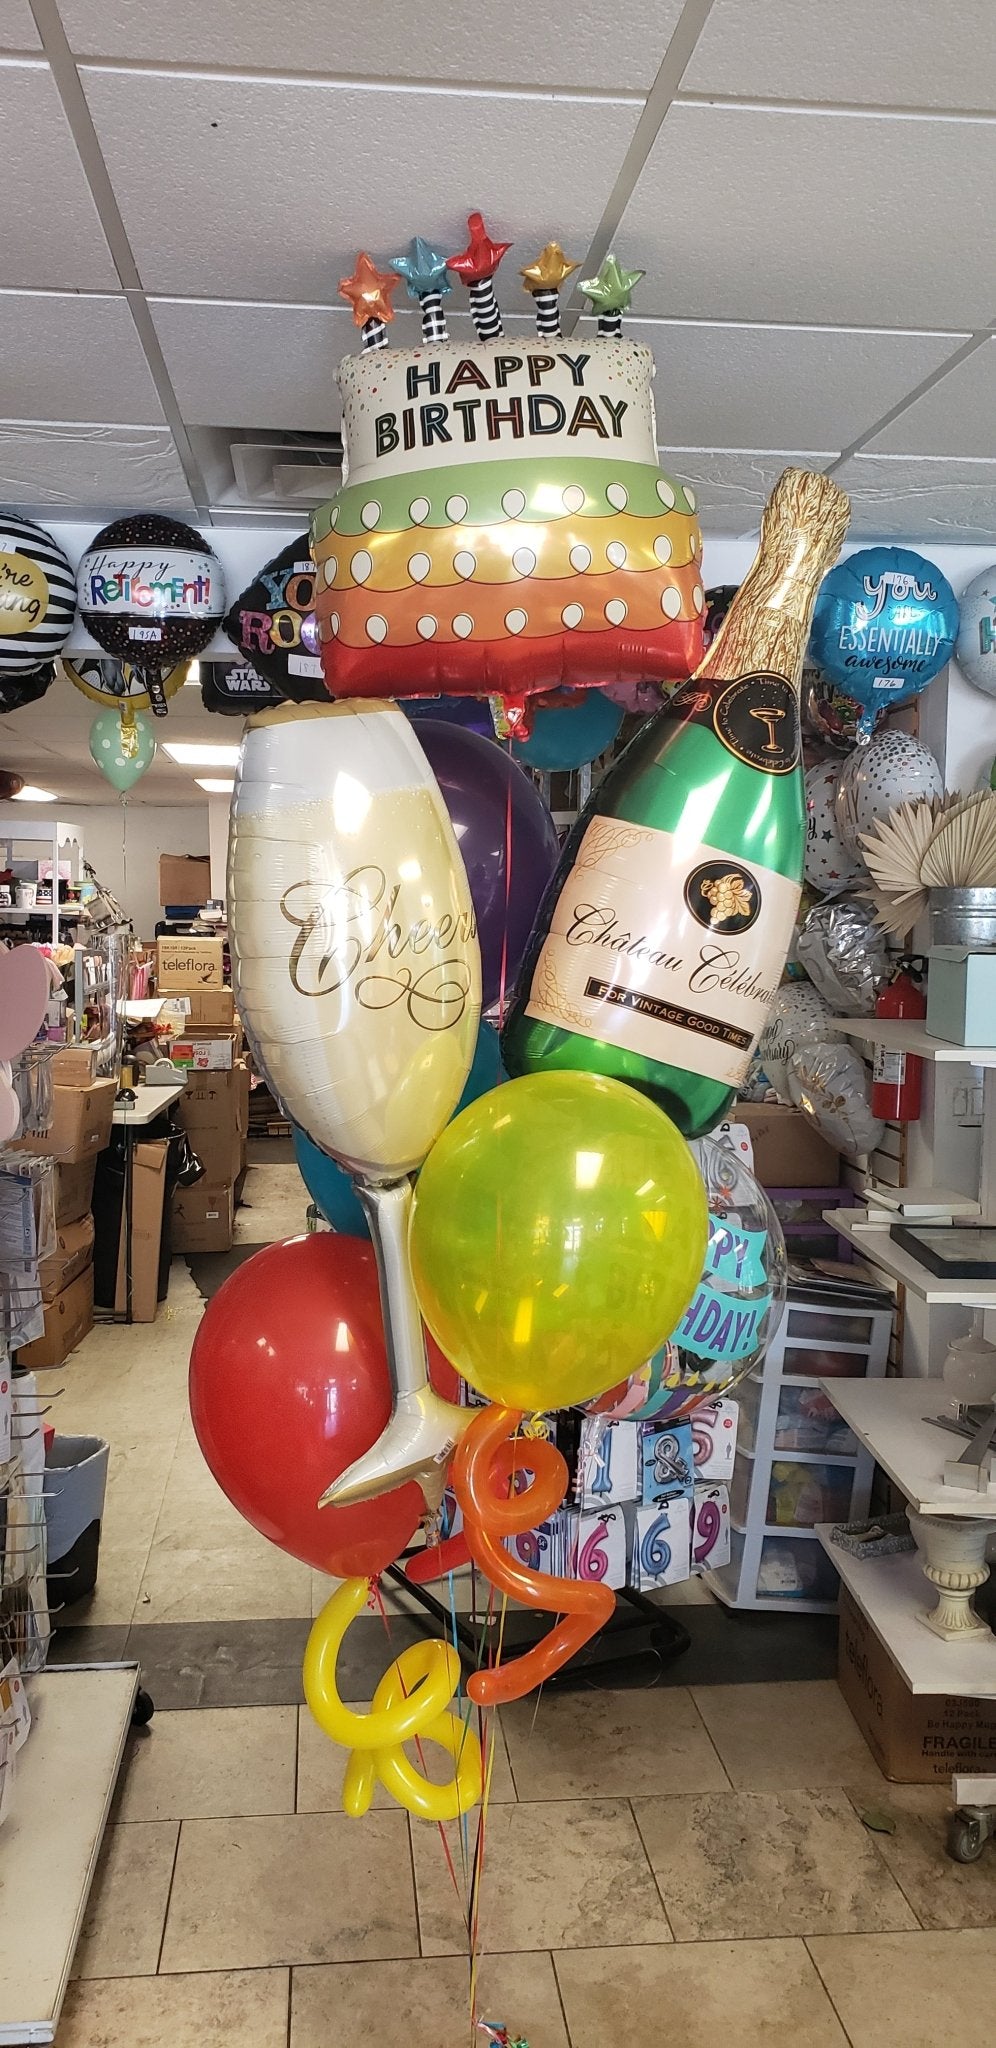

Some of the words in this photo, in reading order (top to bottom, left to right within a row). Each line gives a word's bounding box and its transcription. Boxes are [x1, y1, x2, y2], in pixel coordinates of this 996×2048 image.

[406, 353, 591, 400] HAPPY
[375, 394, 628, 457] BIRTHDAY
[89, 555, 175, 580] Happy
[260, 568, 316, 611] YO
[892, 574, 908, 585] 176
[855, 575, 936, 621] you
[132, 629, 157, 641] 195A
[839, 625, 942, 657] ESSENTIALLY
[844, 655, 926, 675] awesome
[757, 678, 780, 687] Time
[566, 904, 683, 973] Château
[161, 958, 215, 971] teleflora
[598, 985, 626, 1003] FOR
[632, 997, 683, 1023] VINTAGE
[687, 1015, 719, 1035] GOOD
[722, 1027, 747, 1046] TIMES
[927, 1720, 940, 1728] Be
[942, 1720, 973, 1731] Happy
[923, 1736, 996, 1749] FRAGILE
[922, 1750, 953, 1758] Handle
[956, 1750, 975, 1758] with
[934, 1763, 980, 1774] teleflora
